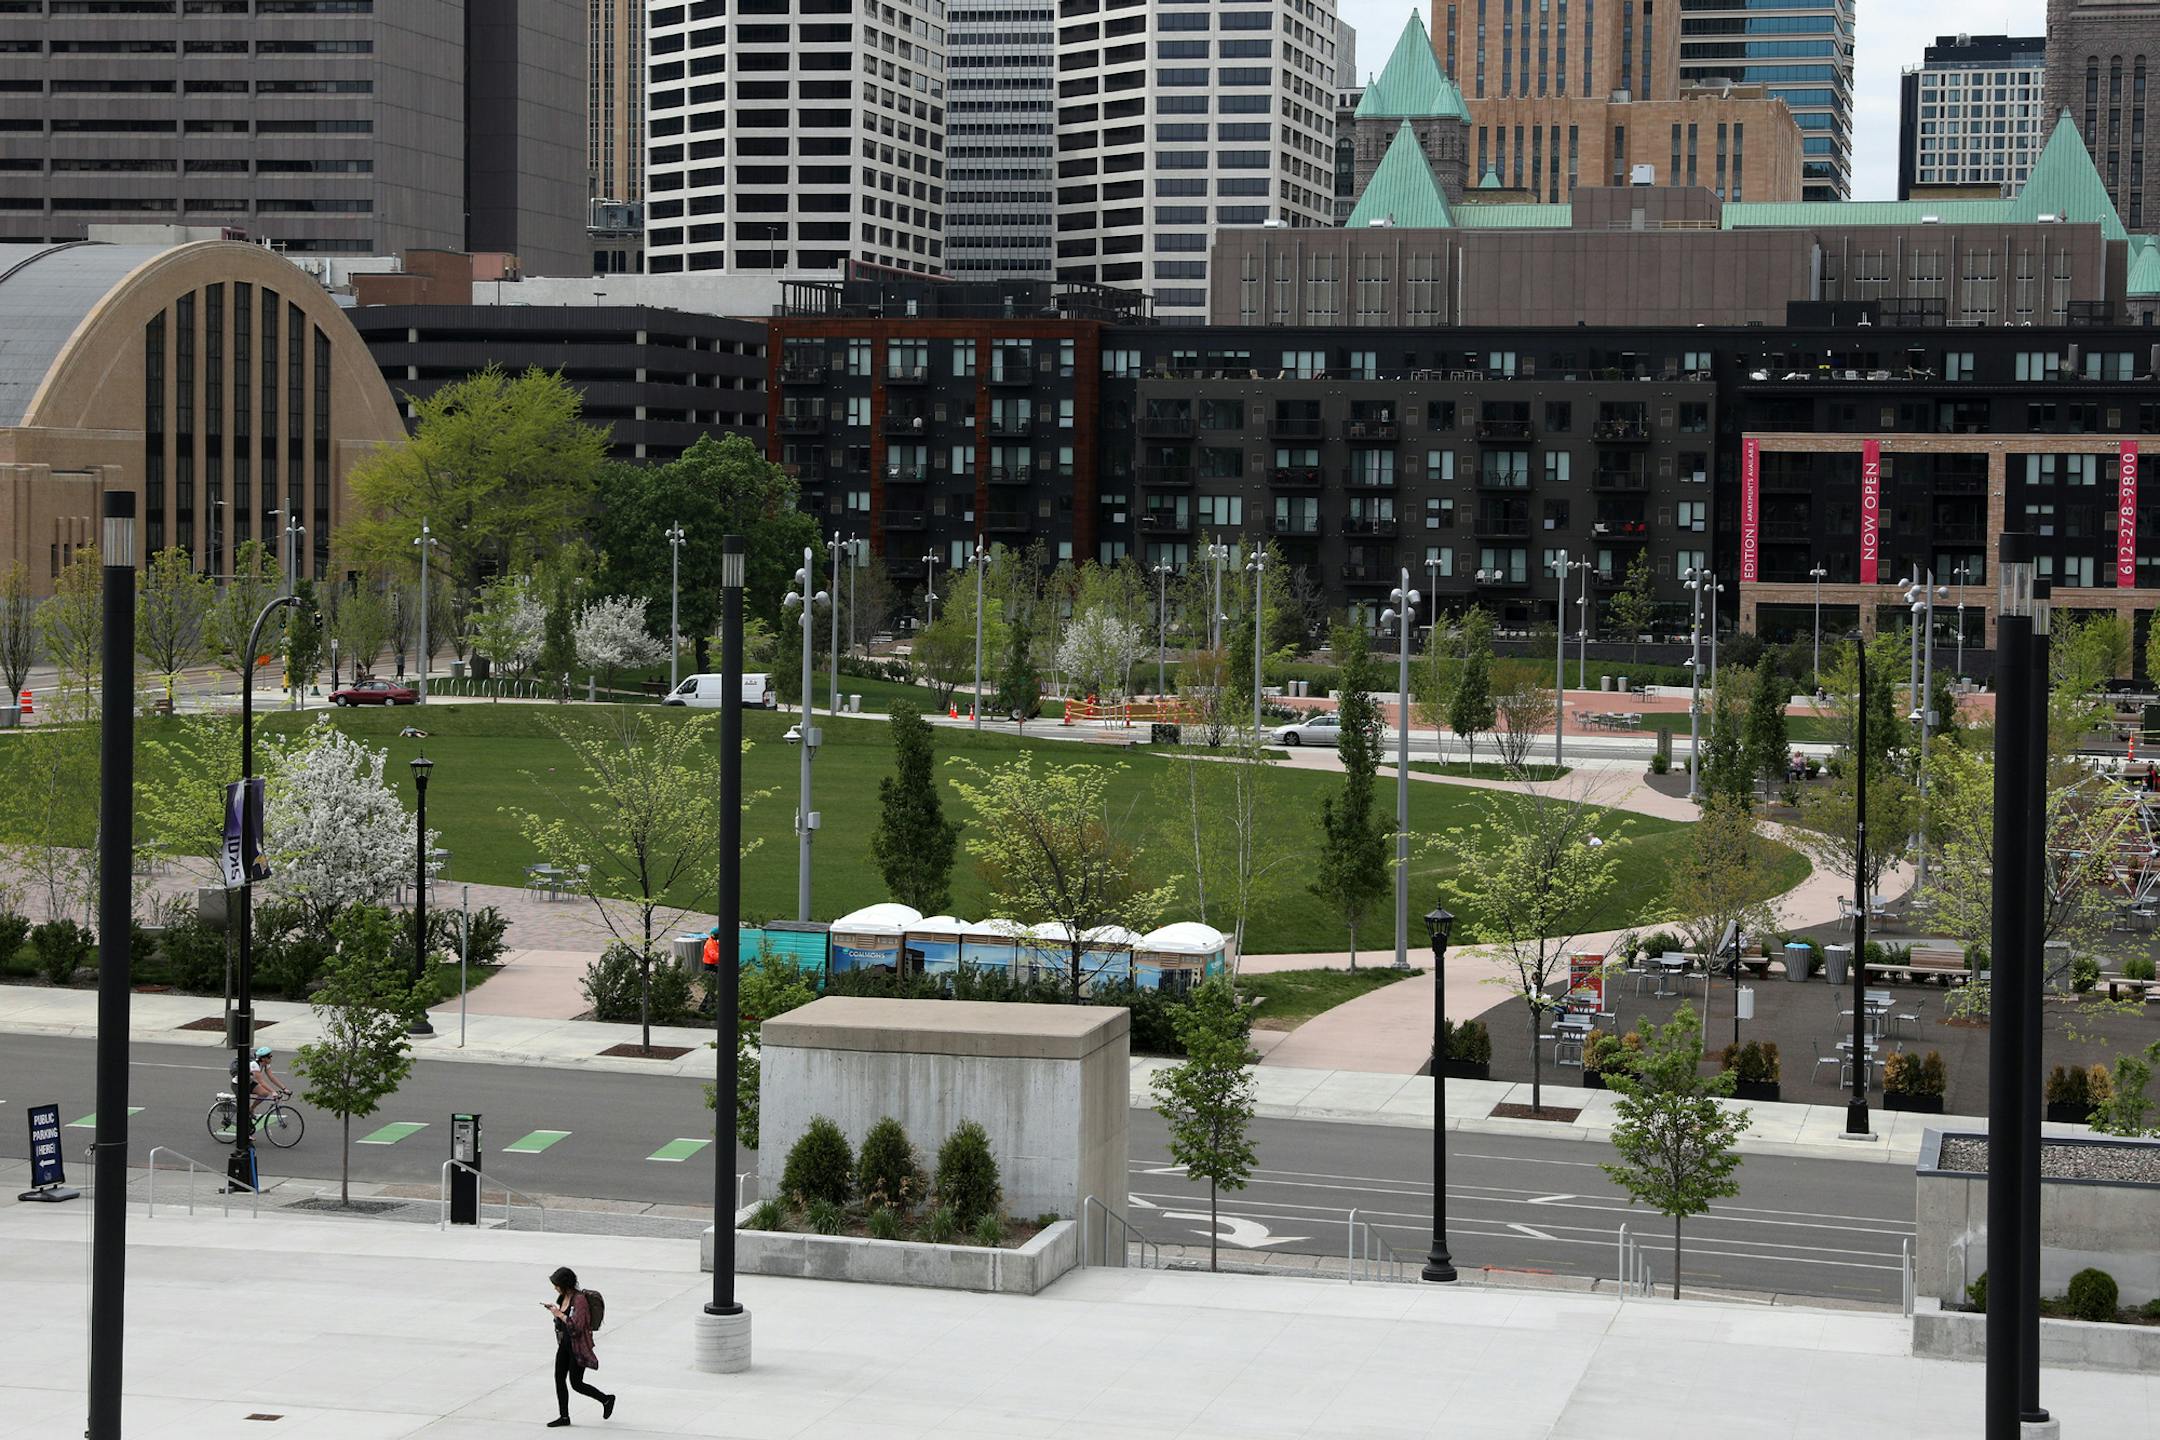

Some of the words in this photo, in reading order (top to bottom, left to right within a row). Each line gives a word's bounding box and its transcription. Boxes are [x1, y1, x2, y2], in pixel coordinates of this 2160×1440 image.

[1864, 463, 1877, 509] OPEN
[2120, 453, 2135, 574] 612-278-9800
[1744, 528, 1755, 578] EDITION
[1864, 515, 1876, 560] NOW
[848, 951, 886, 959] COMMONS
[32, 1127, 59, 1141] PARKING
[33, 1112, 55, 1126] PUBLIC
